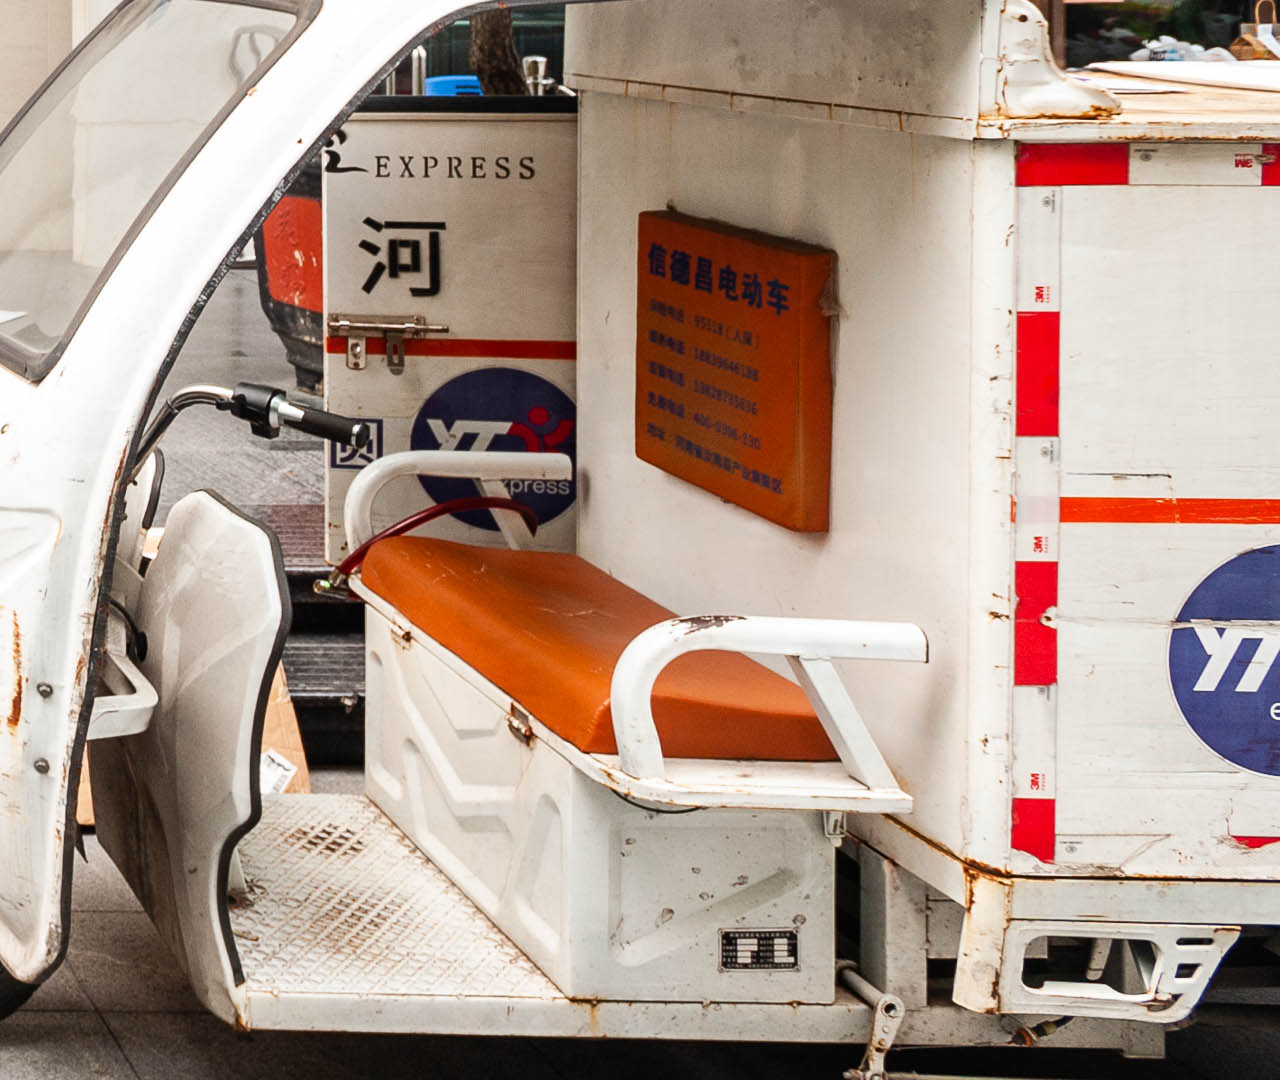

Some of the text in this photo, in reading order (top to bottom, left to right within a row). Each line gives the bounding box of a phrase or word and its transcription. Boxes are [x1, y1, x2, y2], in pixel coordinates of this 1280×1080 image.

[374, 156, 537, 180] EXPRESS
[358, 216, 447, 297] 河
[648, 242, 790, 317] 信德昌电动车
[507, 478, 571, 496] press
